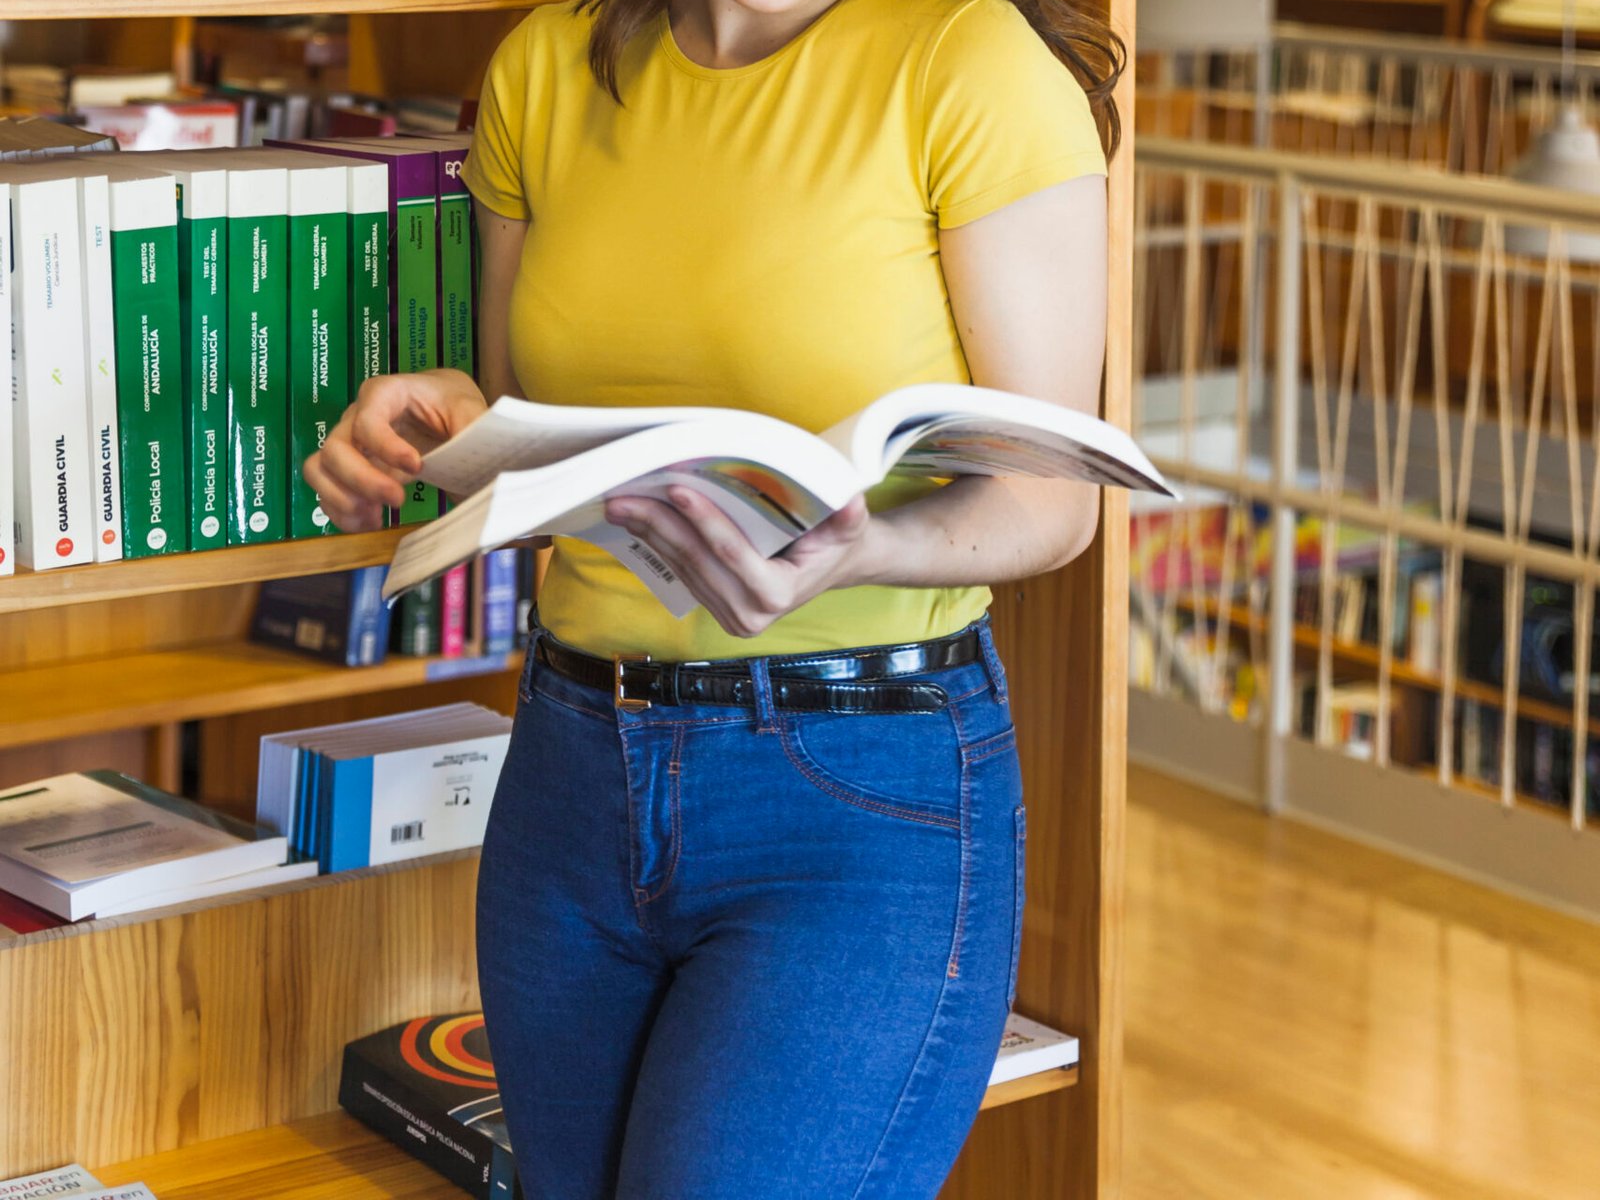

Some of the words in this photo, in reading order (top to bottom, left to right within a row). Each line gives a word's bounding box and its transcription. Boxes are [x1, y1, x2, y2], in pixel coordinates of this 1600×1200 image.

[148, 242, 156, 283] PRÁCTICOS
[142, 315, 148, 325] DE
[251, 312, 257, 321] DE
[417, 307, 428, 350] Málaga
[149, 329, 160, 395] ANDALUCÍA
[258, 327, 268, 391] ANDALUCÍA
[419, 352, 426, 367] de
[56, 435, 66, 470] CIVIL
[101, 425, 110, 460] CIVIL
[148, 441, 161, 477] Local
[253, 426, 265, 460] Local
[57, 472, 69, 532] GUARDIA
[103, 461, 113, 522] GUARDIA
[149, 479, 162, 524] Policía
[253, 464, 265, 507] Policía
[58, 1172, 81, 1181] en
